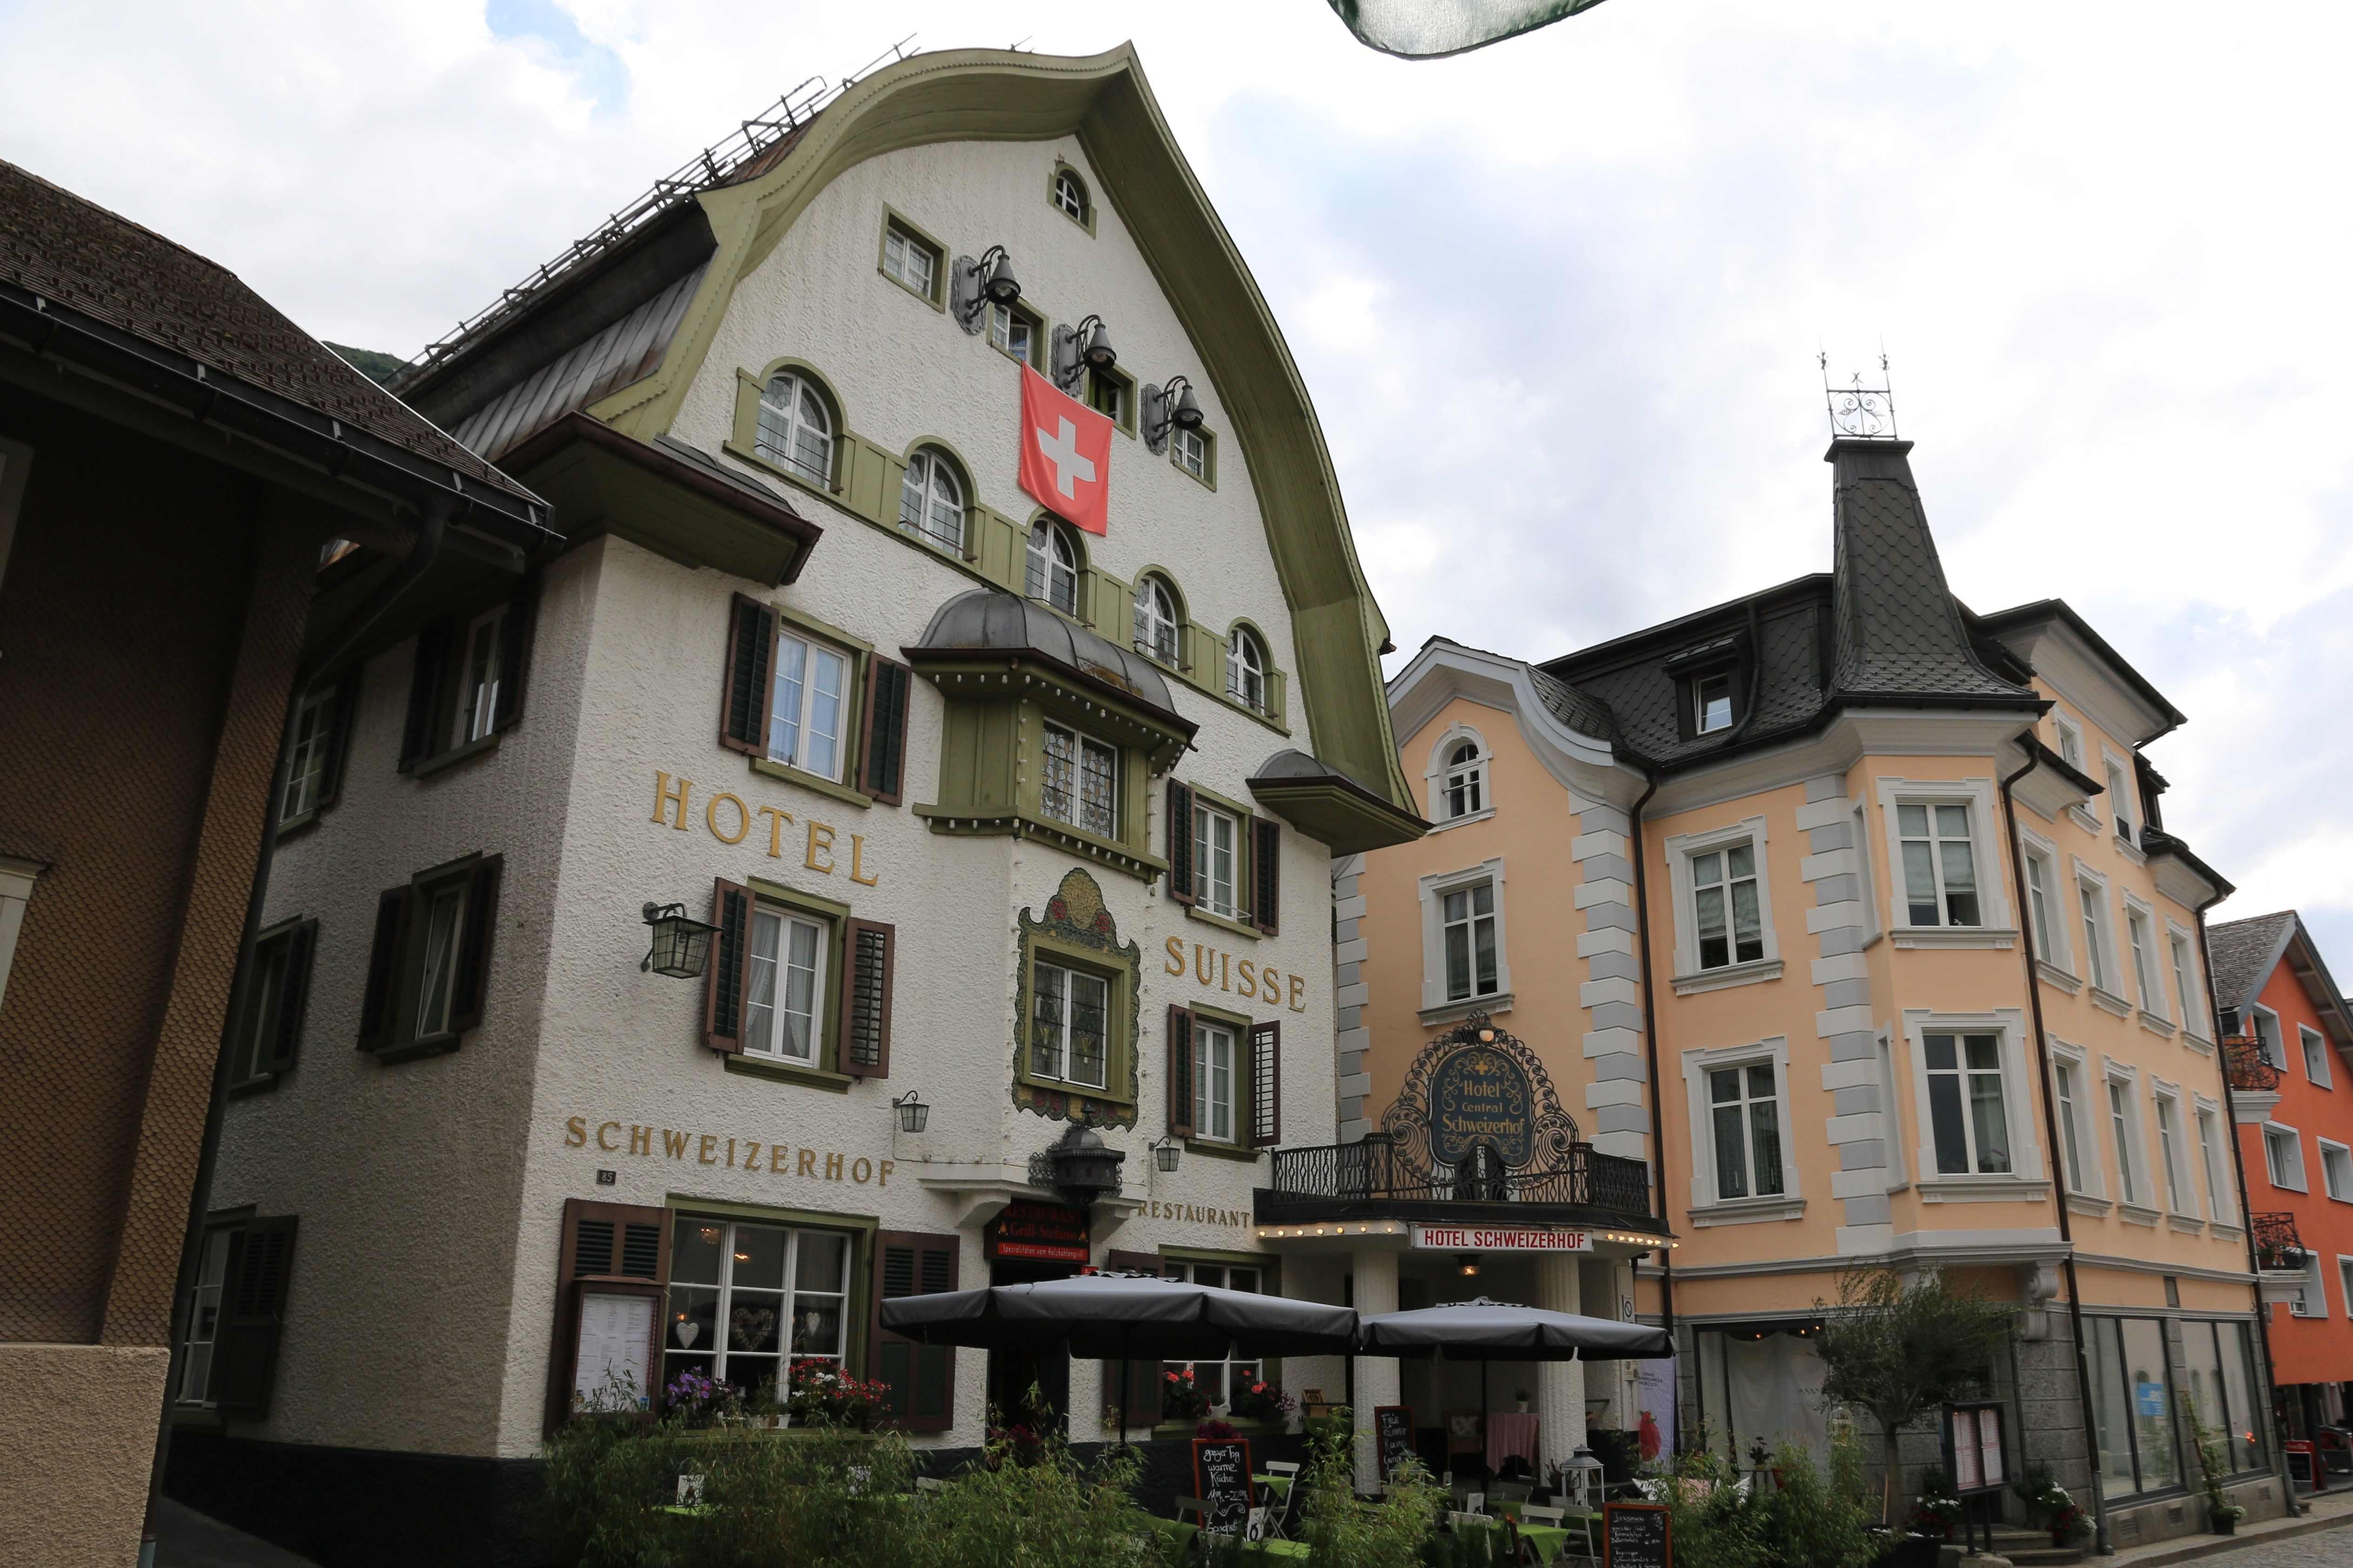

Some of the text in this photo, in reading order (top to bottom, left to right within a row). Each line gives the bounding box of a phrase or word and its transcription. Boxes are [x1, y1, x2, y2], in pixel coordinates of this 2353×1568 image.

[651, 770, 879, 886] HOTEL
[1166, 936, 1306, 1013] SUISSE
[1465, 1080, 1500, 1097] Hotel
[1462, 1103, 1503, 1113] Central
[1442, 1114, 1525, 1135] Schweizerhof
[566, 1116, 894, 1186] SCHWEIZERHOF
[601, 1172, 613, 1182] 85
[1004, 1204, 1082, 1223] RESTAURANT
[1139, 1201, 1250, 1228] RESTAURANT
[1010, 1222, 1077, 1240] Grill-Stefano
[1425, 1230, 1584, 1249] HOTEL SCHWEIZERHOF
[1003, 1244, 1035, 1254] Spezialitäten
[1048, 1248, 1083, 1259] Holzkohlengrill
[1381, 1413, 1400, 1426] Freie
[1382, 1425, 1407, 1436] Zimmer
[1203, 1446, 1240, 1463] ganzer Tag
[1384, 1438, 1407, 1455] Rooms
[1208, 1463, 1237, 1472] warme
[1211, 1471, 1236, 1488] Küche
